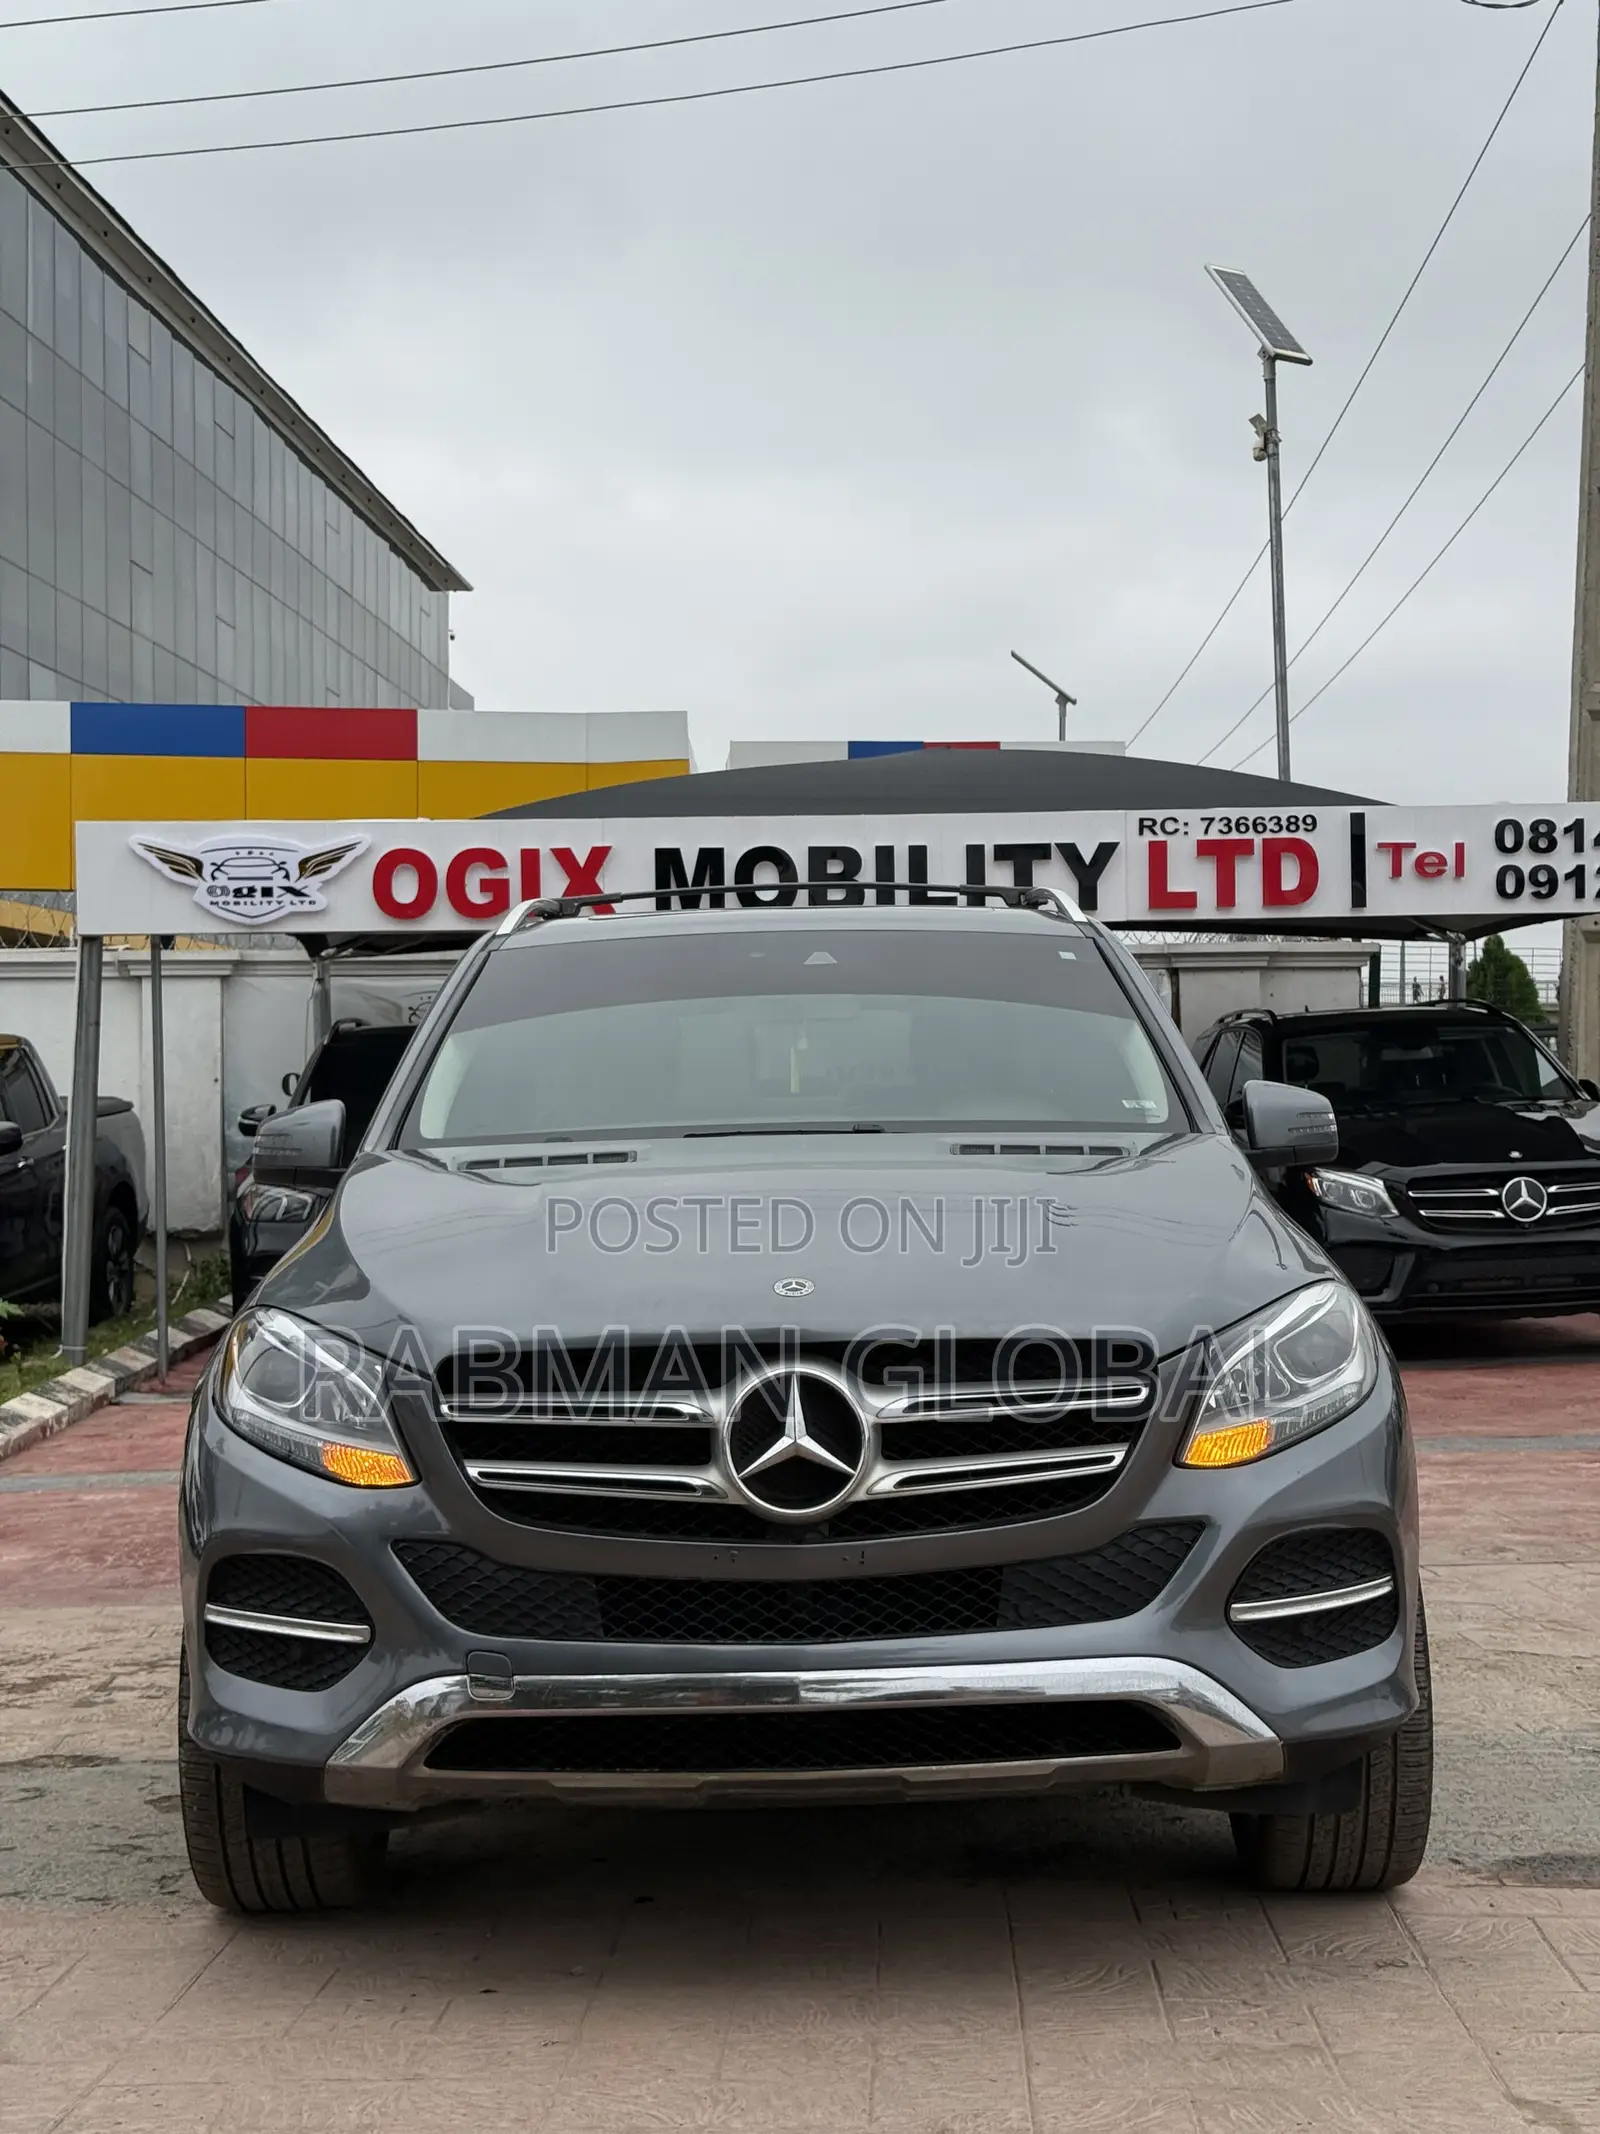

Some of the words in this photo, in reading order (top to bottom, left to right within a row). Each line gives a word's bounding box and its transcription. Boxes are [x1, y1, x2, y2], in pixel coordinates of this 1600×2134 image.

[1137, 816, 1190, 837] RC:
[1200, 813, 1318, 835] 7366389
[1493, 817, 1600, 855] 081
[372, 845, 618, 920] OGIX
[653, 841, 1121, 911] MOBILITY
[1148, 836, 1320, 910] LTD
[1376, 841, 1466, 879] Tel
[1495, 863, 1600, 900] 091
